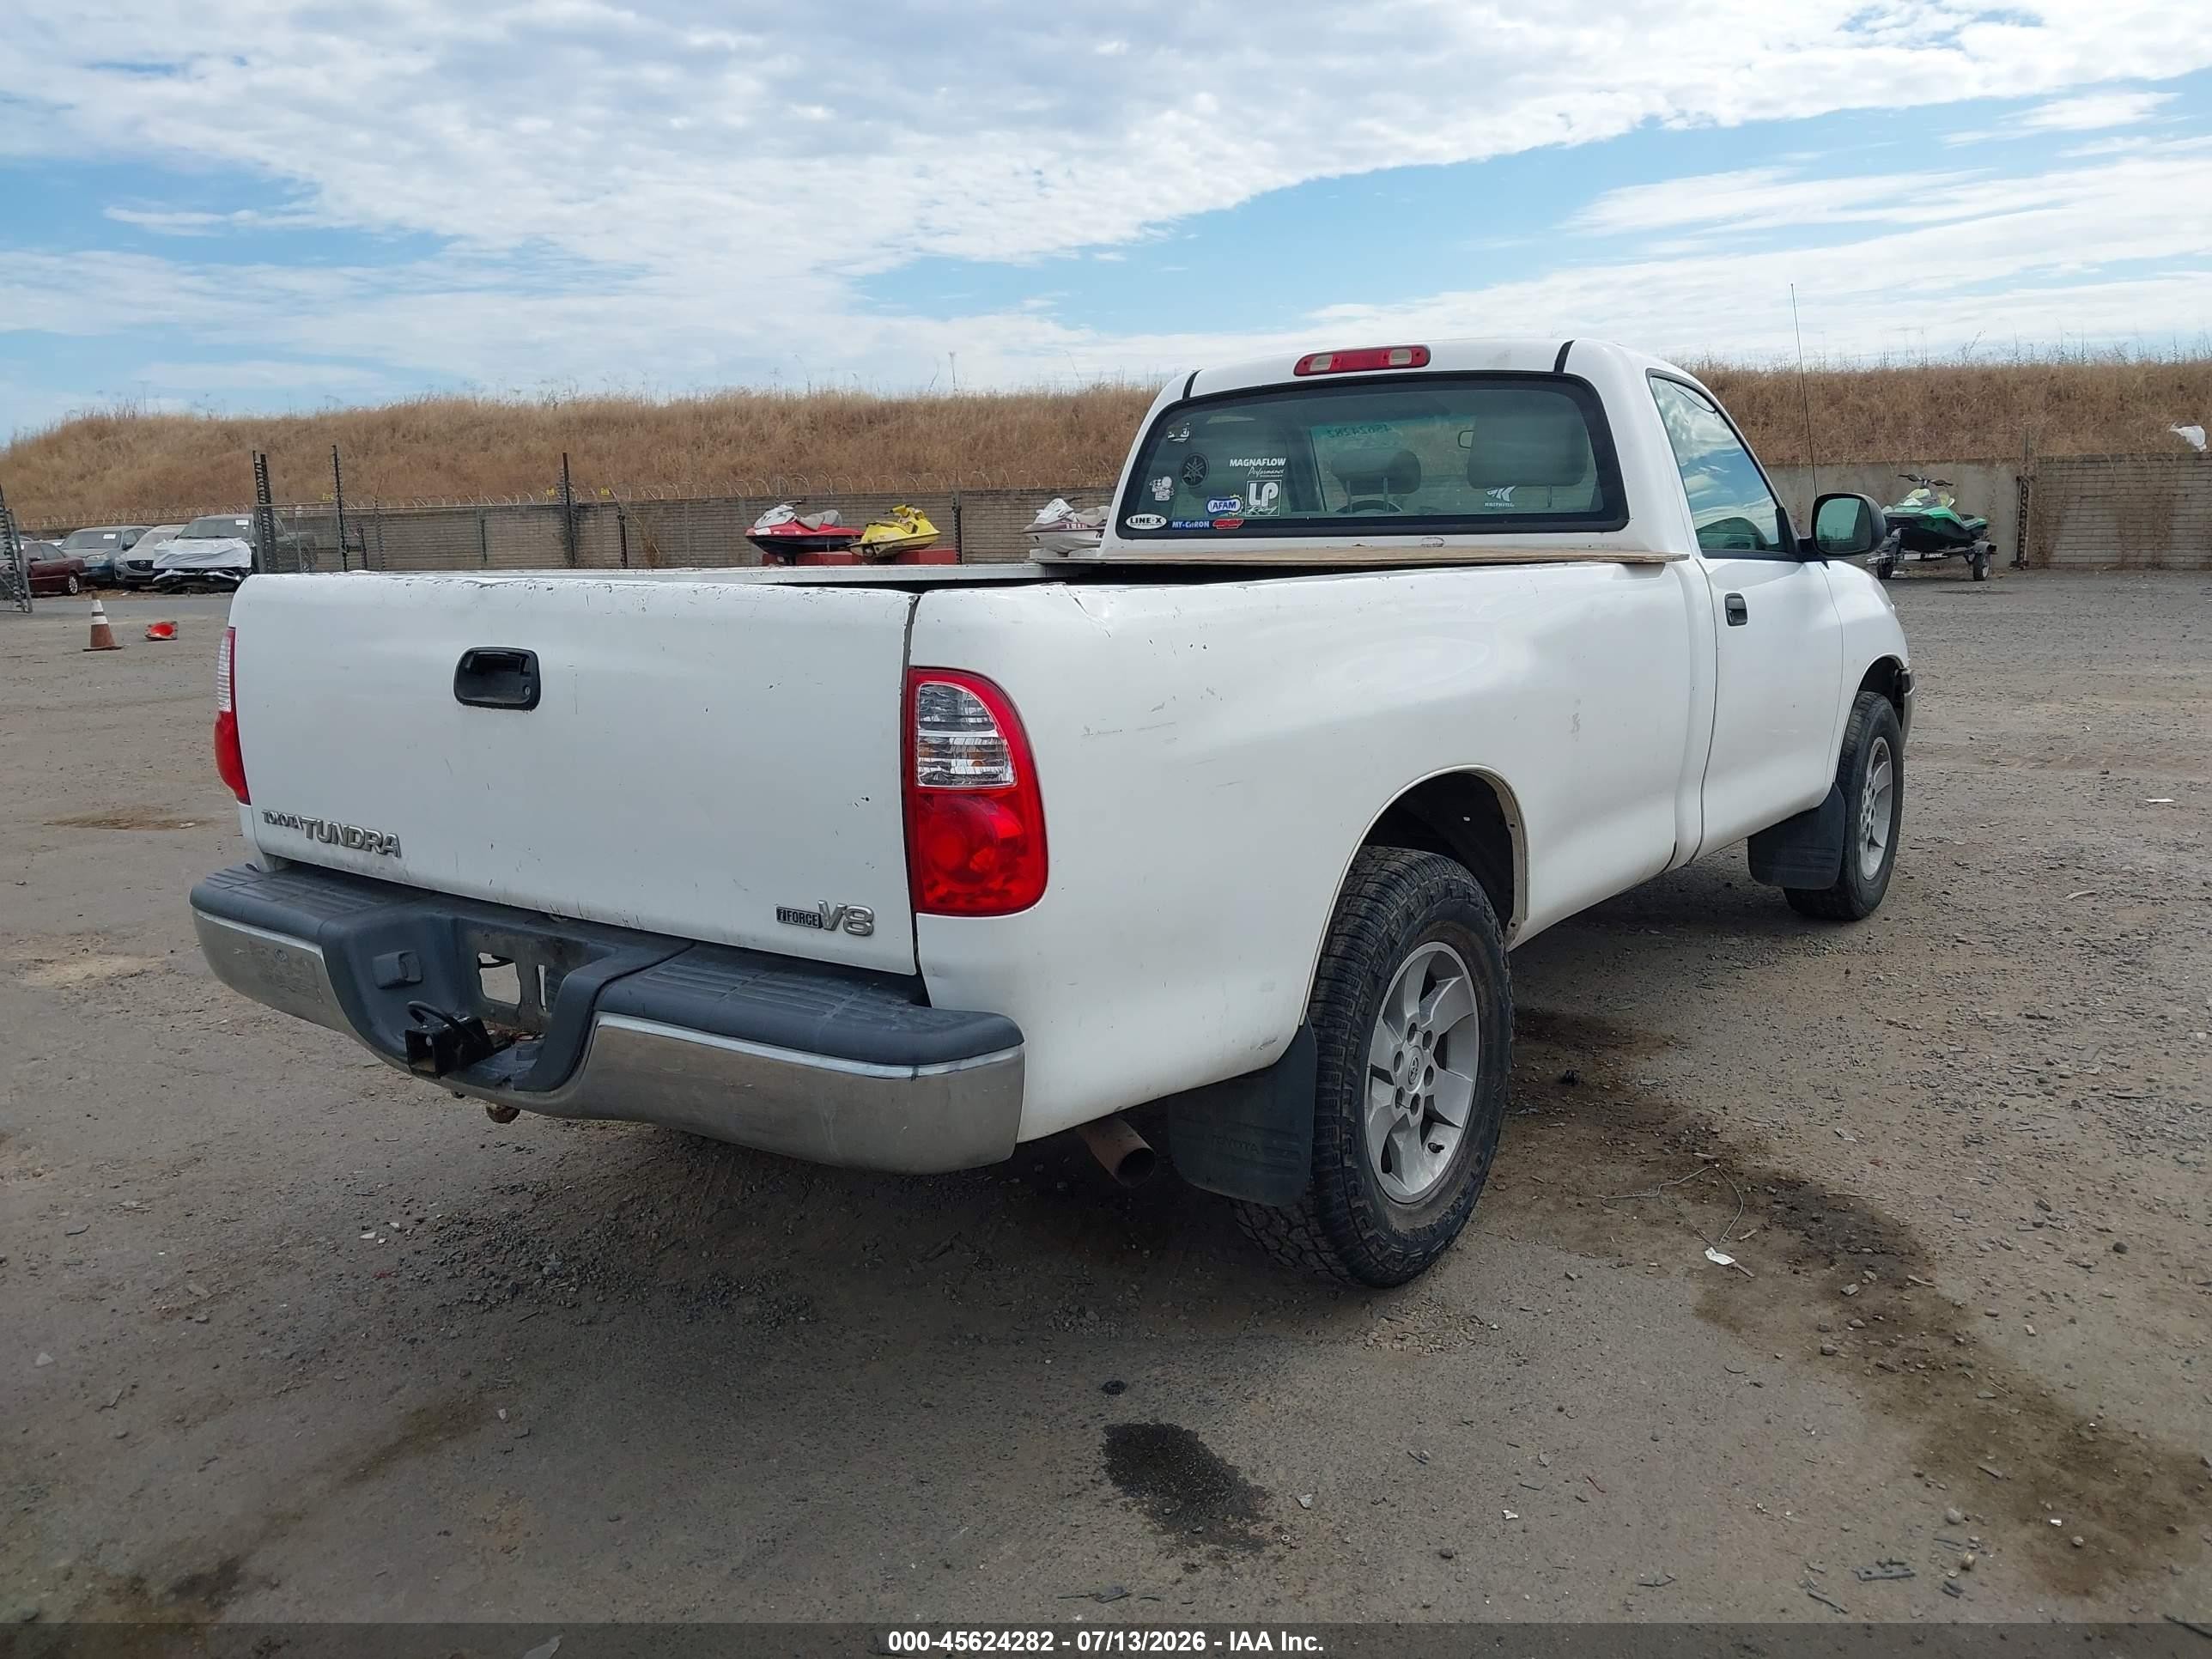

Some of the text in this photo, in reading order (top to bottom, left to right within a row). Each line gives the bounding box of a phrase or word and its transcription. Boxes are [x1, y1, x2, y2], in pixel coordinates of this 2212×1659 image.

[1229, 458, 1286, 467] MAGNAFLOW
[1212, 501, 1237, 510] AFAM
[1249, 482, 1279, 507] LP
[261, 810, 402, 859] TOYOTA TUNDRA
[817, 899, 874, 937] V8
[1211, 1133, 1260, 1155] TOYOTA
